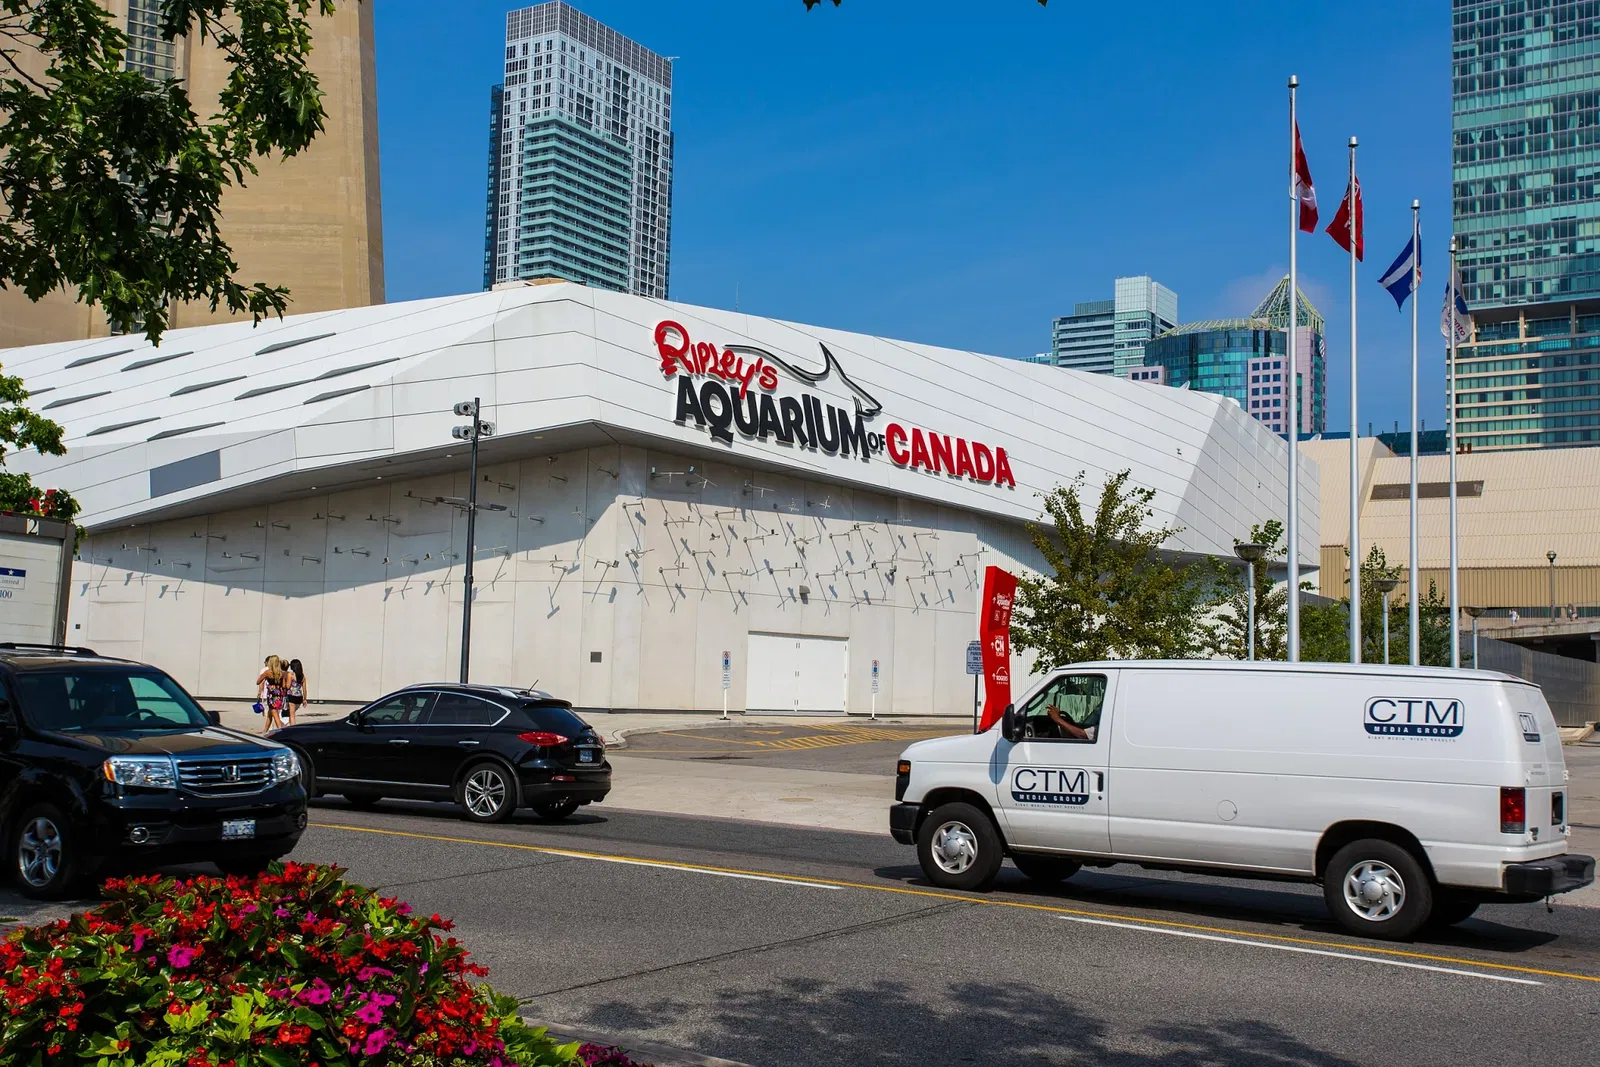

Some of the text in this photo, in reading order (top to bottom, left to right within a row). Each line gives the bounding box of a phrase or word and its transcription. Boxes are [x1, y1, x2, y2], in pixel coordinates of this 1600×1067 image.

[675, 375, 1016, 487] AQUARIUM OF CANADA
[27, 519, 38, 535] 2
[1368, 699, 1458, 725] CTM
[1416, 727, 1454, 735] GROUP
[1015, 769, 1085, 793] CTM
[1053, 795, 1082, 803] GROUP
